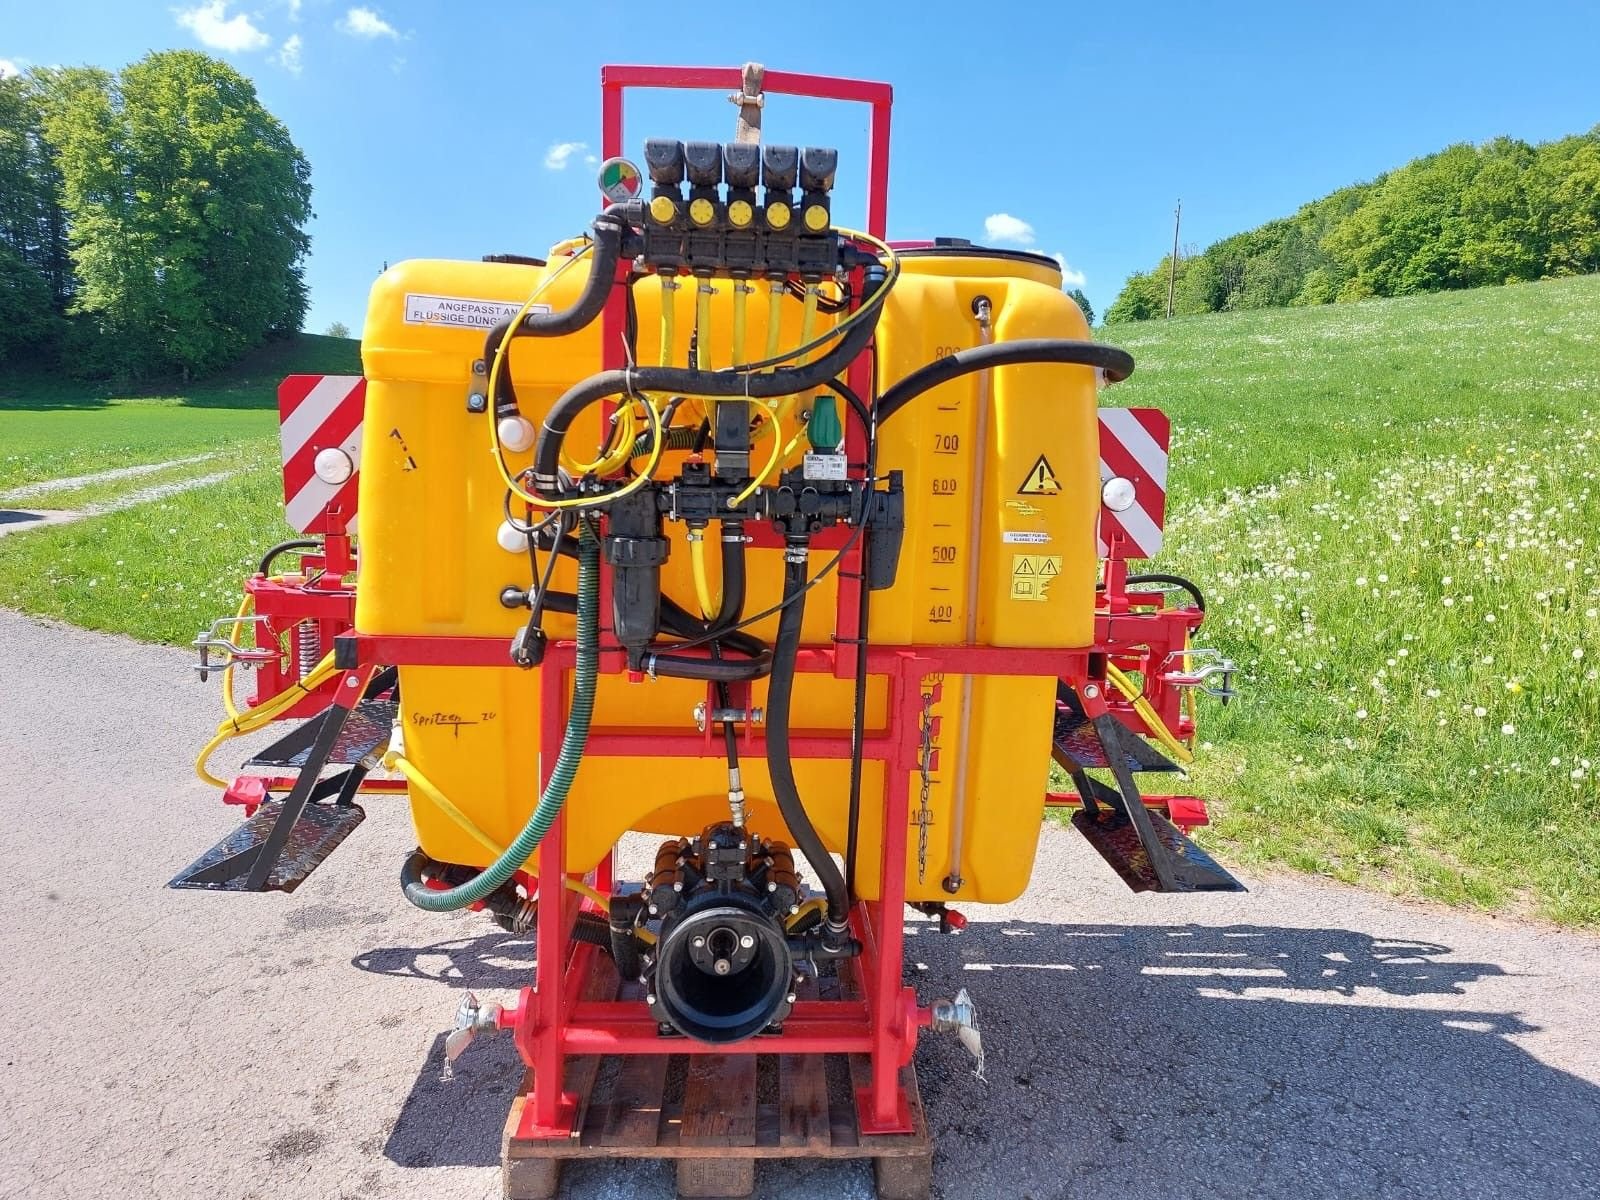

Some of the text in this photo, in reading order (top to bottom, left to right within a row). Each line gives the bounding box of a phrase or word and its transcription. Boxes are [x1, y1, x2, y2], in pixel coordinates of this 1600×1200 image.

[437, 302, 500, 315] ANGEPASST
[935, 434, 959, 451] 700
[932, 479, 957, 492] 600
[932, 546, 956, 562] 500
[929, 605, 952, 618] 400
